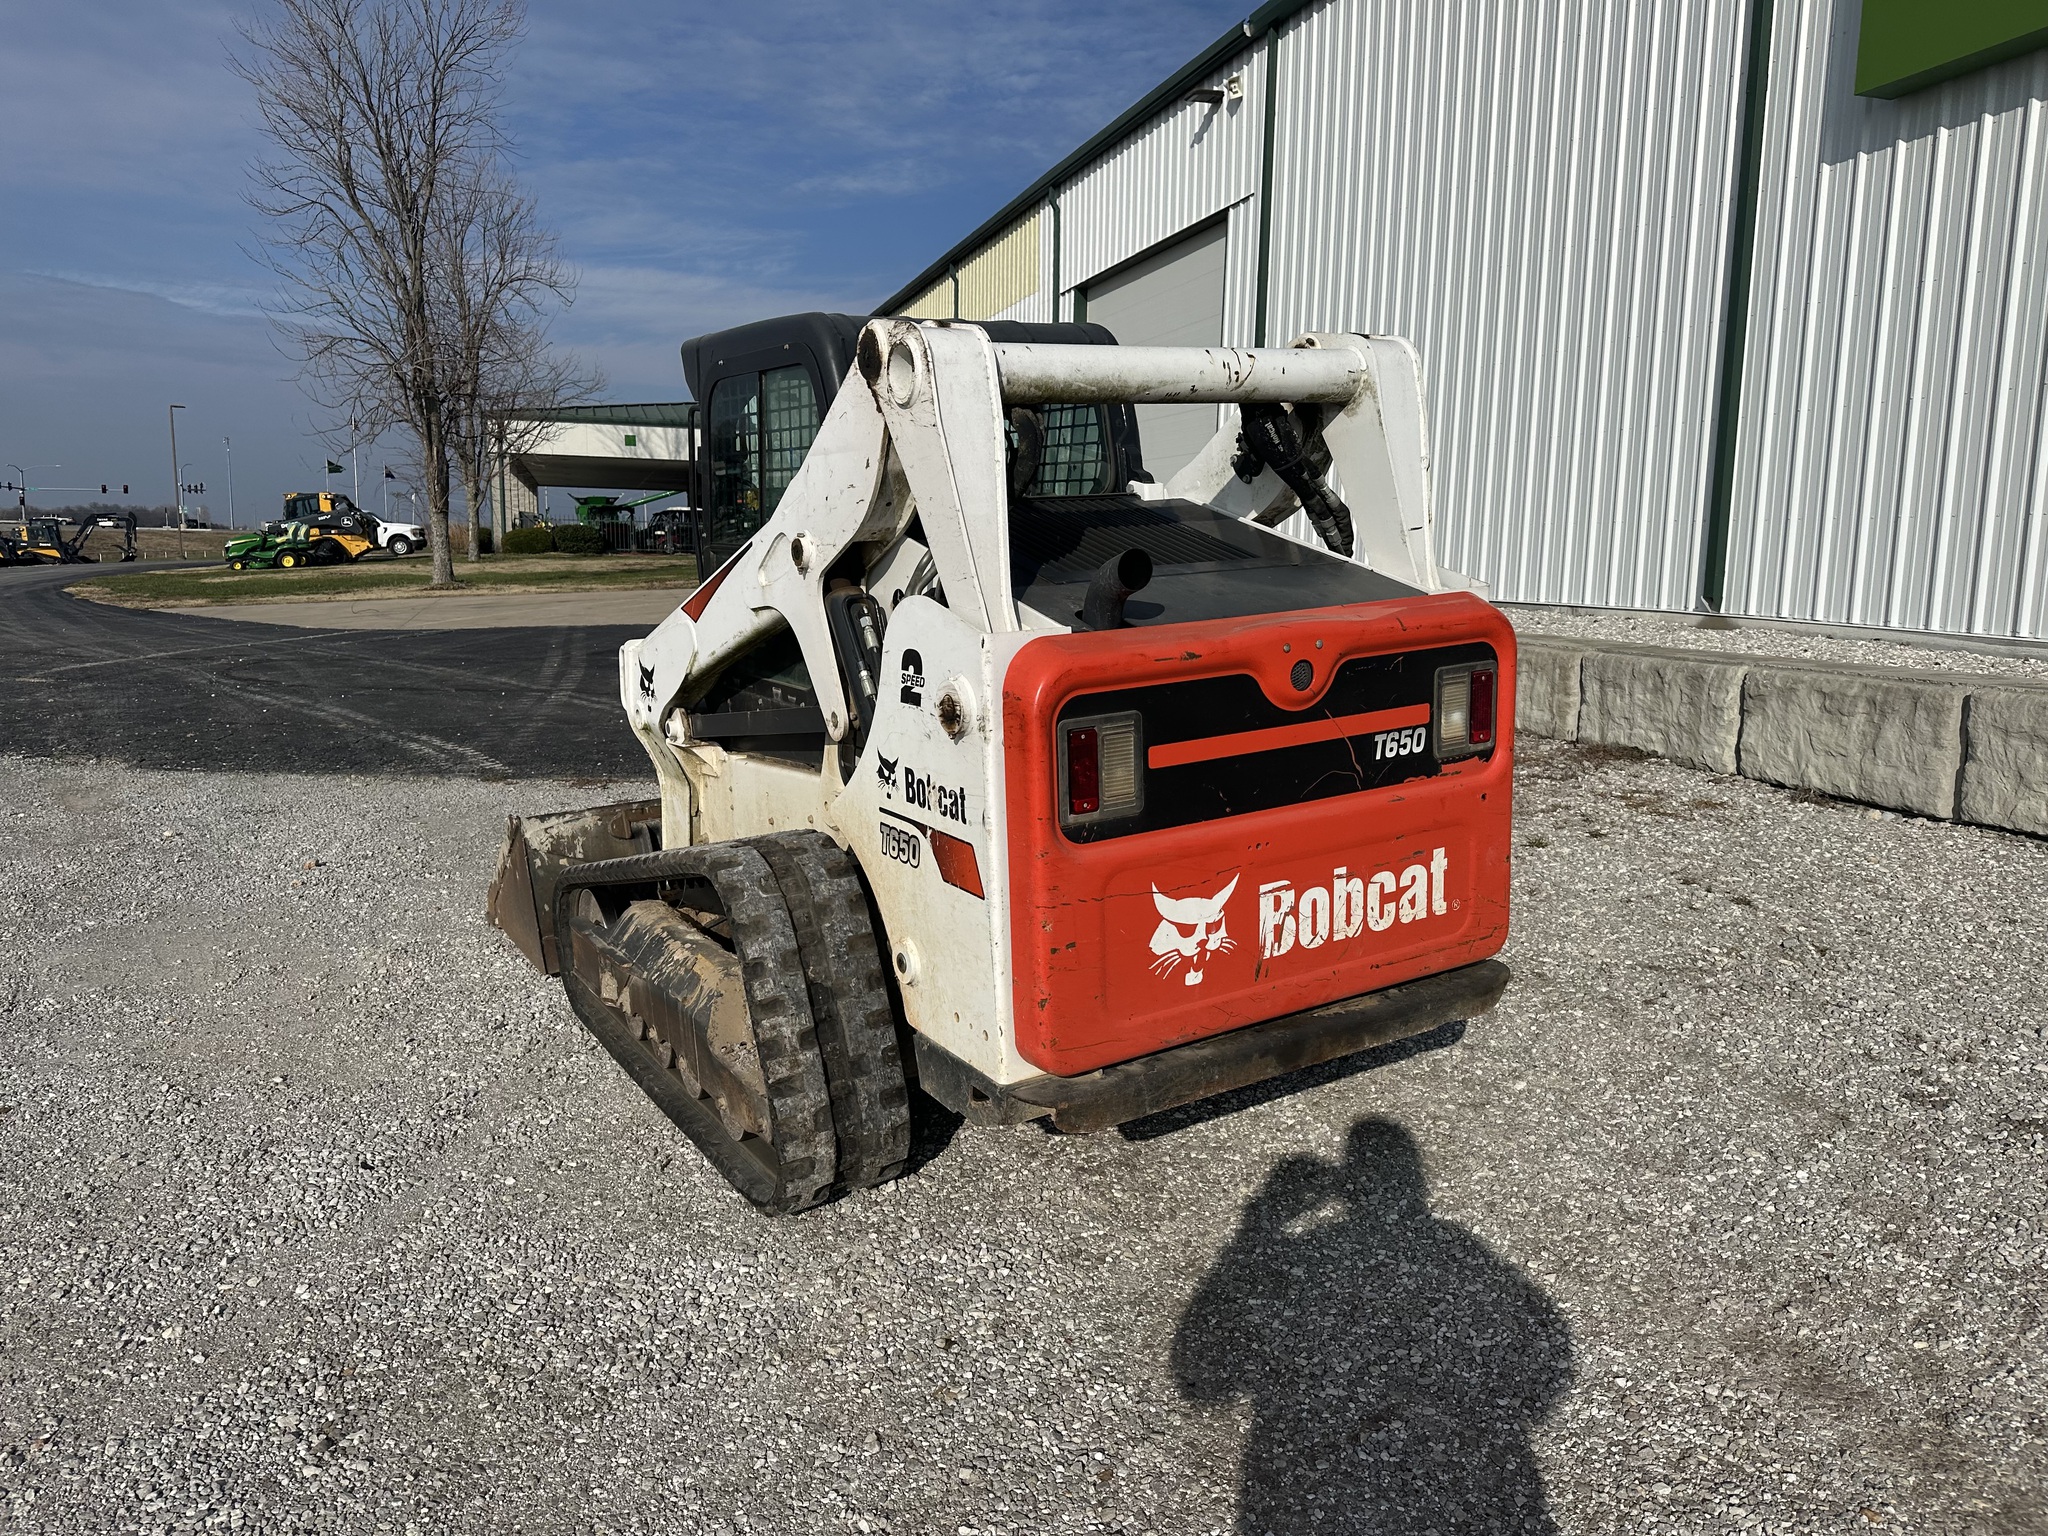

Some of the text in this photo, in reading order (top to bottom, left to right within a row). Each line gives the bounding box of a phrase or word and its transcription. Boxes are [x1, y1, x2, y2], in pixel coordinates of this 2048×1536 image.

[900, 648, 922, 707] 2
[901, 672, 925, 688] SPEED
[1374, 727, 1426, 760] T650
[880, 822, 921, 868] T650
[1259, 847, 1448, 960] Bobcat
